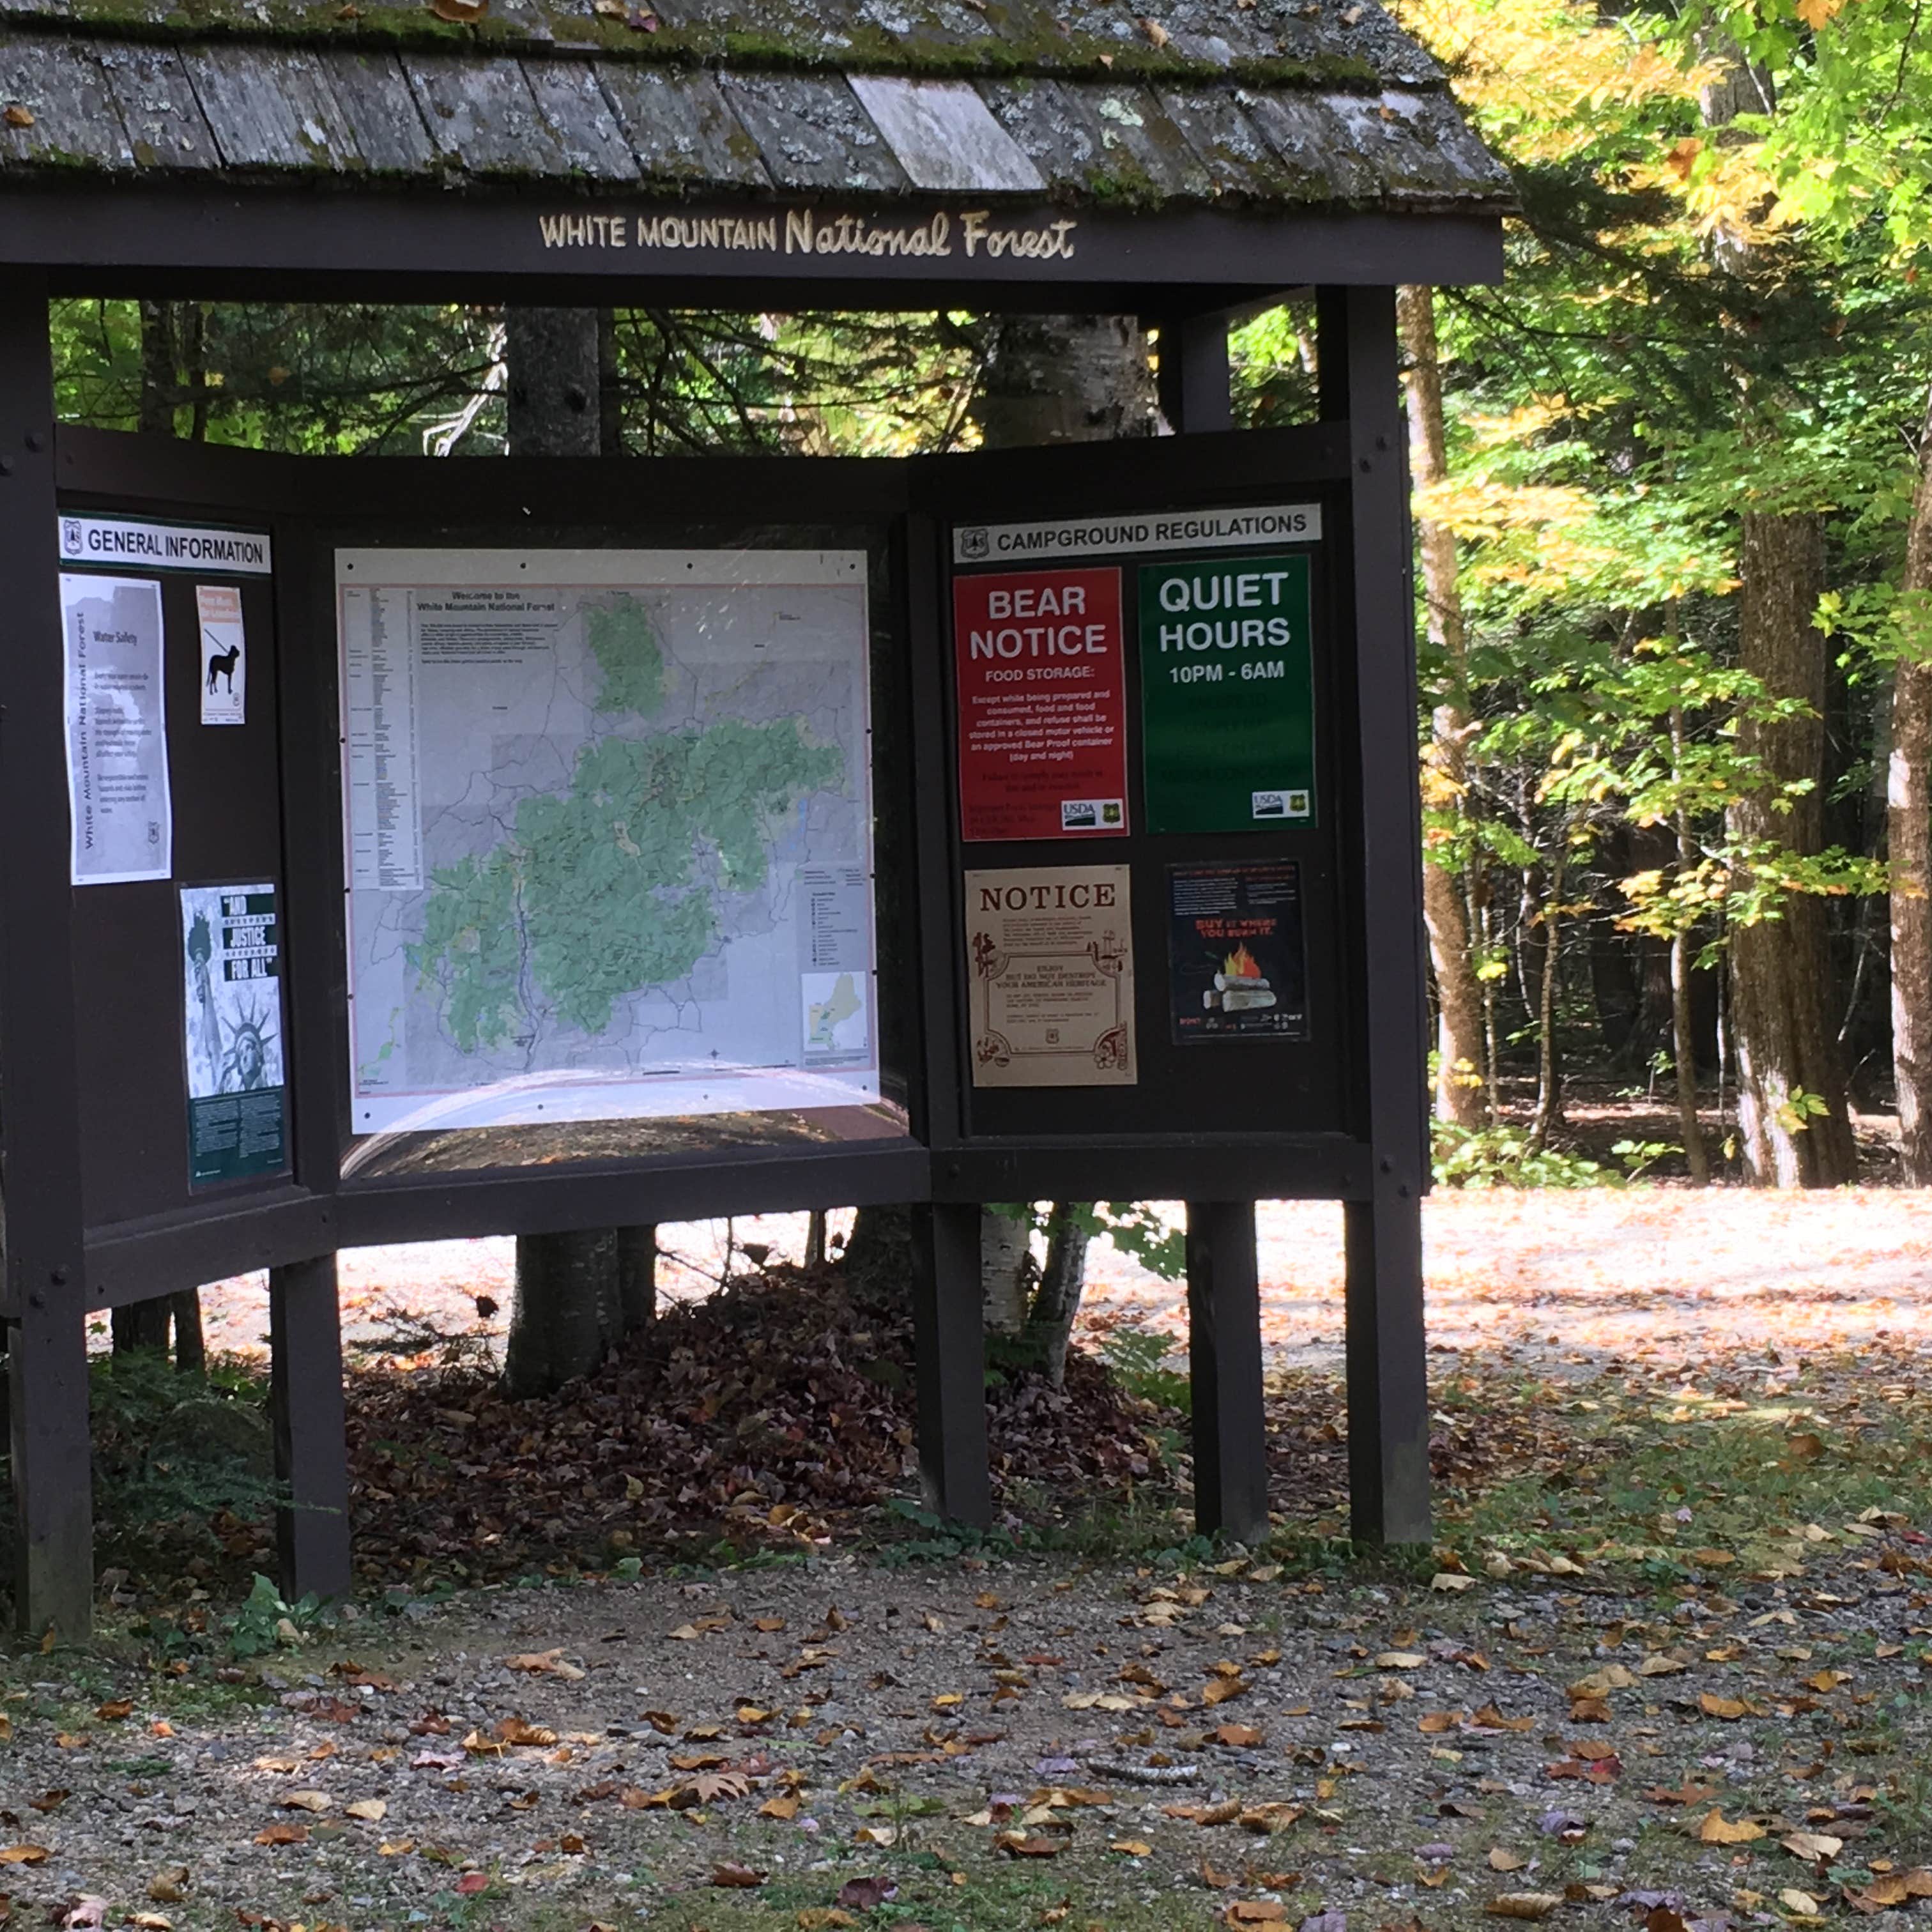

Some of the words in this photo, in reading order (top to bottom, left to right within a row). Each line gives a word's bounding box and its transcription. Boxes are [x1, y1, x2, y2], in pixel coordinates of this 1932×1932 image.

[539, 214, 626, 248] WHITE
[638, 216, 777, 251] MOUNTAIN
[785, 209, 951, 256] National
[960, 210, 1078, 259] Forest
[88, 529, 162, 556] GENERAL
[165, 535, 263, 564] INFORMATION
[997, 525, 1150, 552] CAMPGROUND
[1155, 514, 1307, 542] REGULATIONS
[417, 603, 443, 611] White
[445, 603, 486, 611] Mountain
[488, 603, 525, 611] National
[526, 602, 555, 611] Forest
[988, 586, 1085, 619] BEAR
[1160, 572, 1289, 612] QUIET
[76, 612, 85, 658] Forest
[970, 624, 1108, 660] NOTICE
[1160, 617, 1291, 652] HOURS
[985, 669, 1023, 682] FOOD
[1026, 666, 1095, 680] STORAGE:
[1169, 664, 1223, 684] 10PM
[1241, 660, 1284, 680] 6AM
[78, 664, 87, 726] National
[79, 731, 92, 801] Mountain
[1064, 803, 1095, 815] USDA
[85, 804, 94, 850] White
[980, 884, 1115, 911] NOTICE
[230, 926, 266, 947] JUSTICE
[1196, 919, 1224, 930] BUY
[1202, 929, 1224, 938] YOU
[232, 959, 249, 979] FOR
